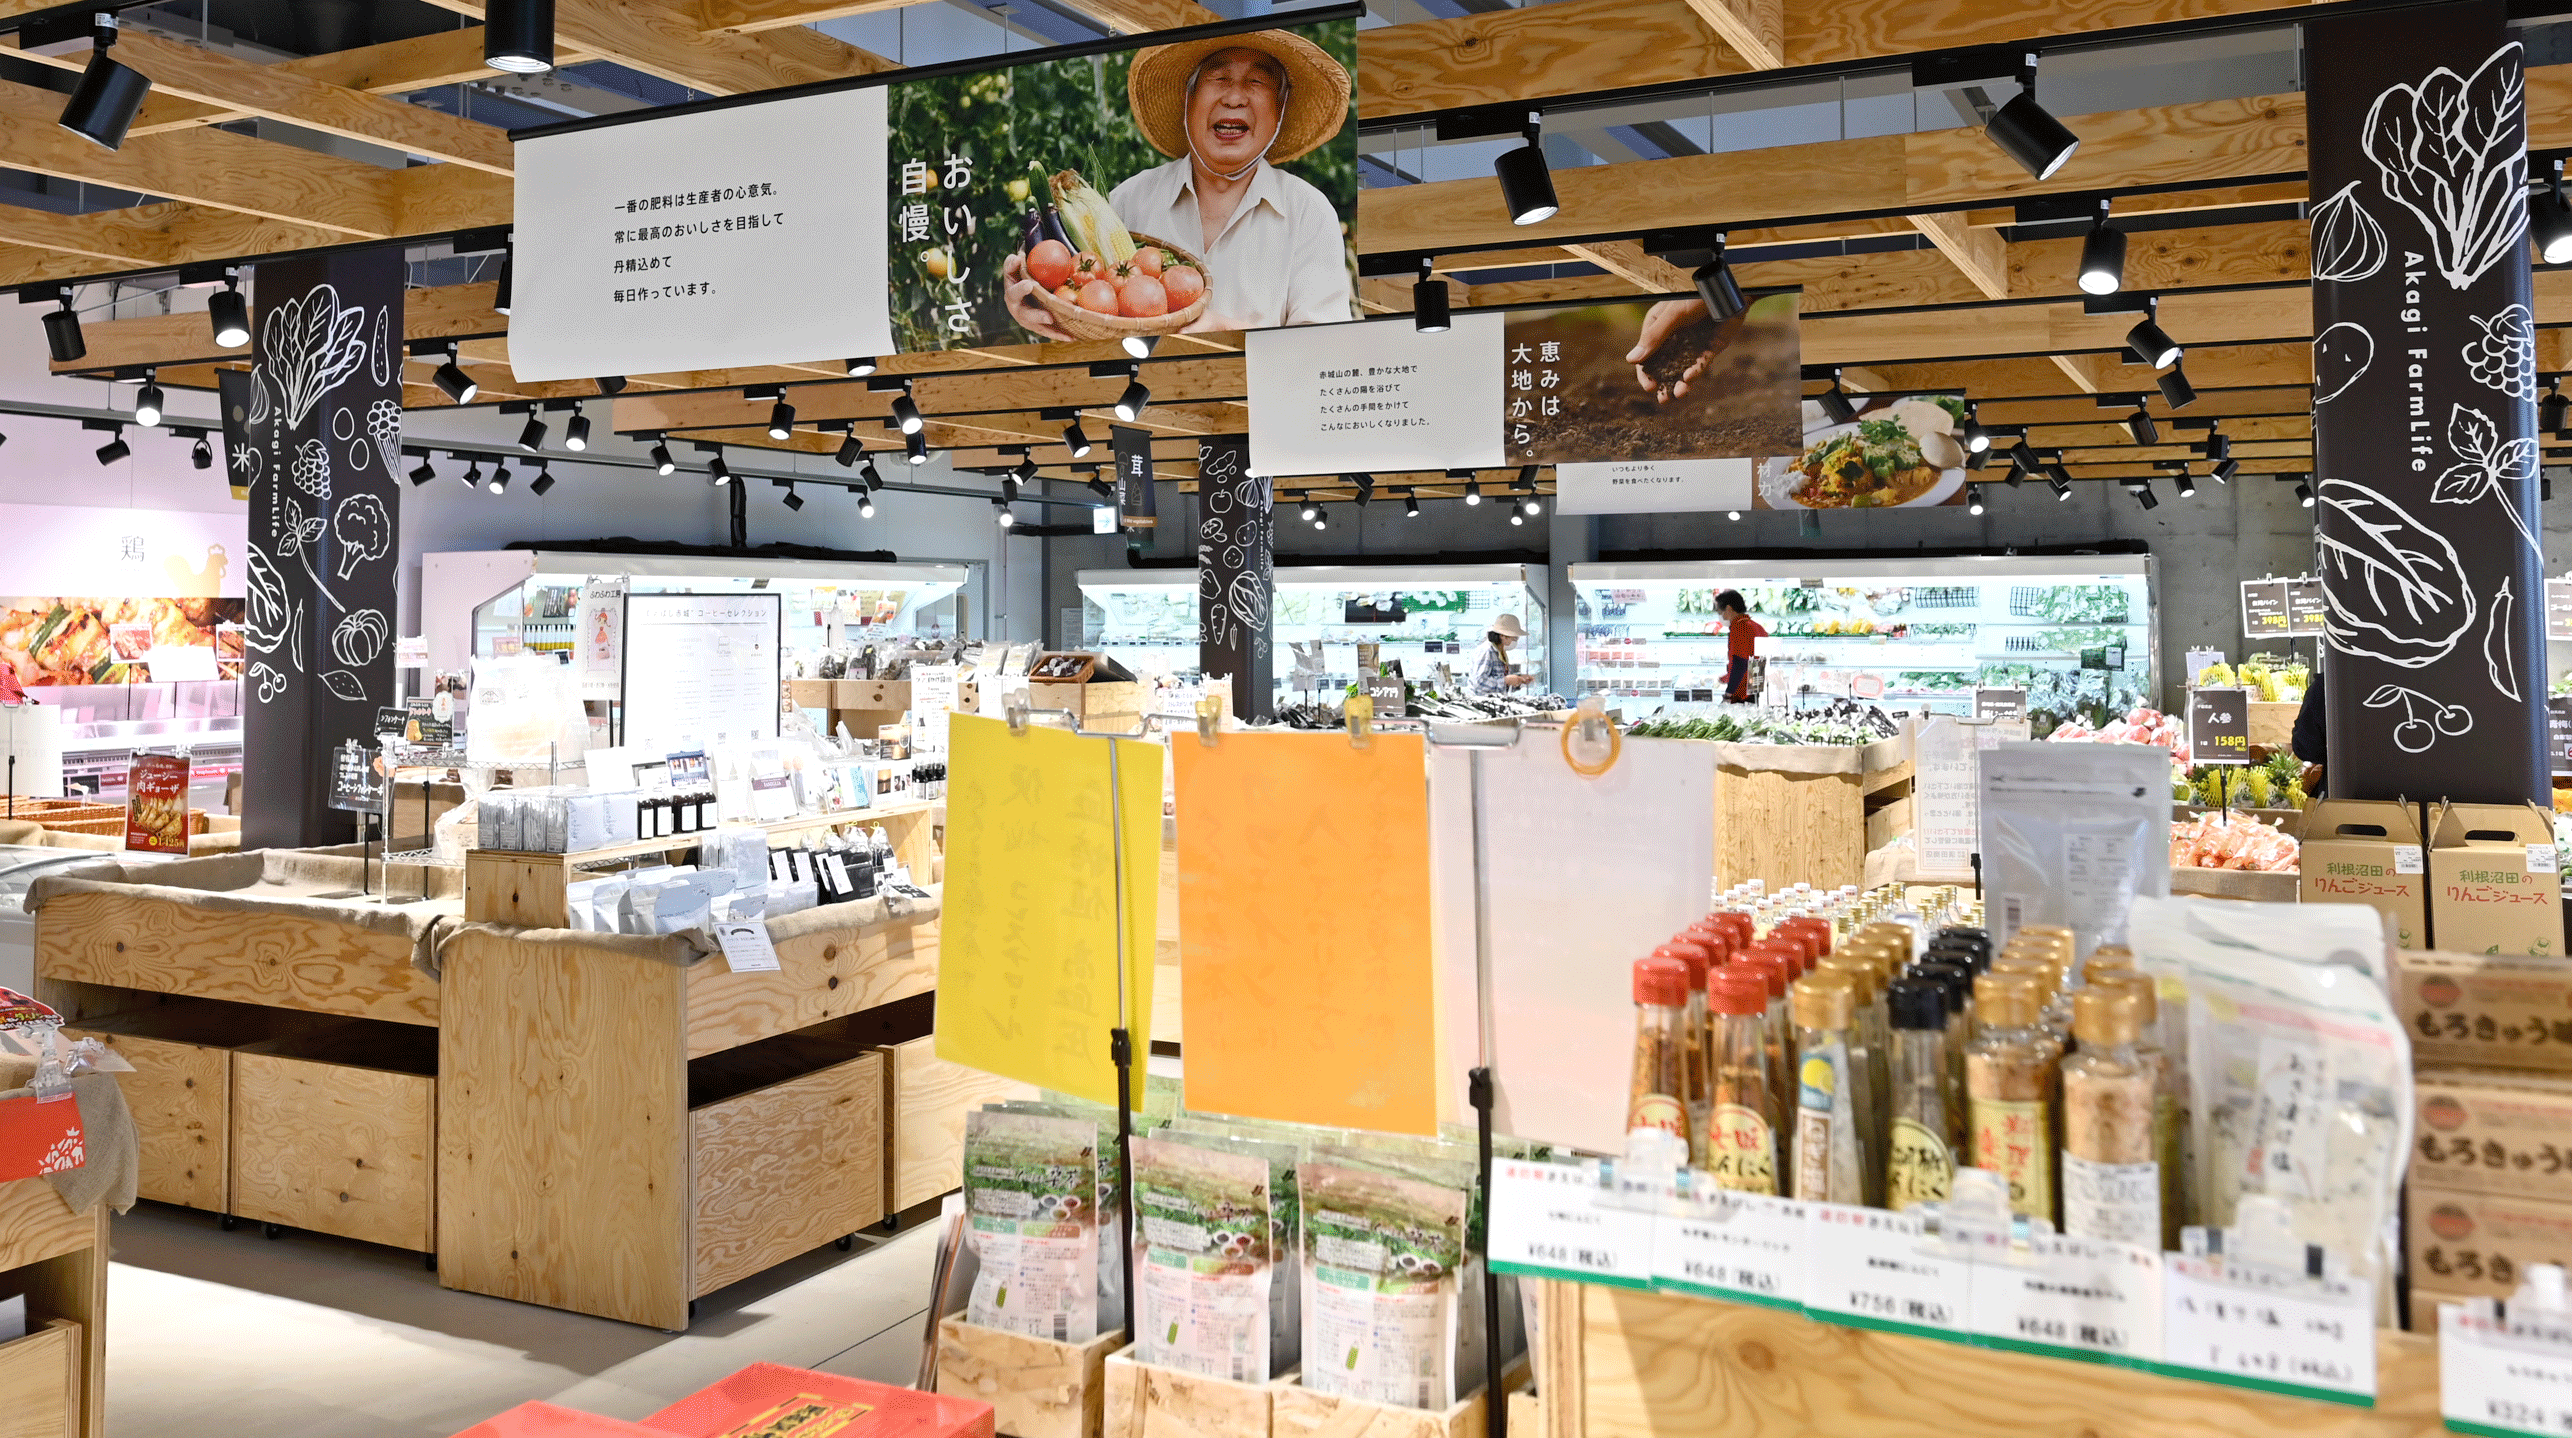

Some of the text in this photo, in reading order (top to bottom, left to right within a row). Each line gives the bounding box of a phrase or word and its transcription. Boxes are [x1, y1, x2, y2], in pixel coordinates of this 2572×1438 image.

[614, 181, 779, 213] 一番の肥料は生産者の心意気。
[898, 157, 930, 264] 自慢。
[614, 212, 785, 244] 常に最高のおいしさを目指して
[942, 153, 973, 333] おいしさ
[613, 255, 673, 274] 丹精込めて
[613, 281, 717, 304] 毎日作っています。
[2401, 251, 2433, 472] Akagi FarmLife
[1319, 364, 1418, 380] 赤城山の麓、豊かな大地で
[1539, 341, 1561, 417] 恵みは
[1320, 382, 1401, 397] たくさんの陽を浴びて
[1320, 400, 1409, 415] たくさんの手間をかけて
[1511, 343, 1534, 457] 大地から。
[271, 406, 282, 455] Akagi
[1320, 416, 1431, 432] こんなにおいしくなりました。
[1131, 454, 1144, 478] 茸
[1612, 476, 1685, 485] 野菜を食べたくなります。
[121, 535, 145, 562] 鶏
[2215, 735, 2246, 747] 158円
[140, 769, 179, 781] ジューシー
[136, 782, 180, 794] 肉ギョーザ
[2326, 862, 2396, 877] 利根沼田の
[2459, 869, 2533, 884] 利根沼田の
[2314, 878, 2410, 897] りんごジュース
[2447, 886, 2548, 905] りんごジュース
